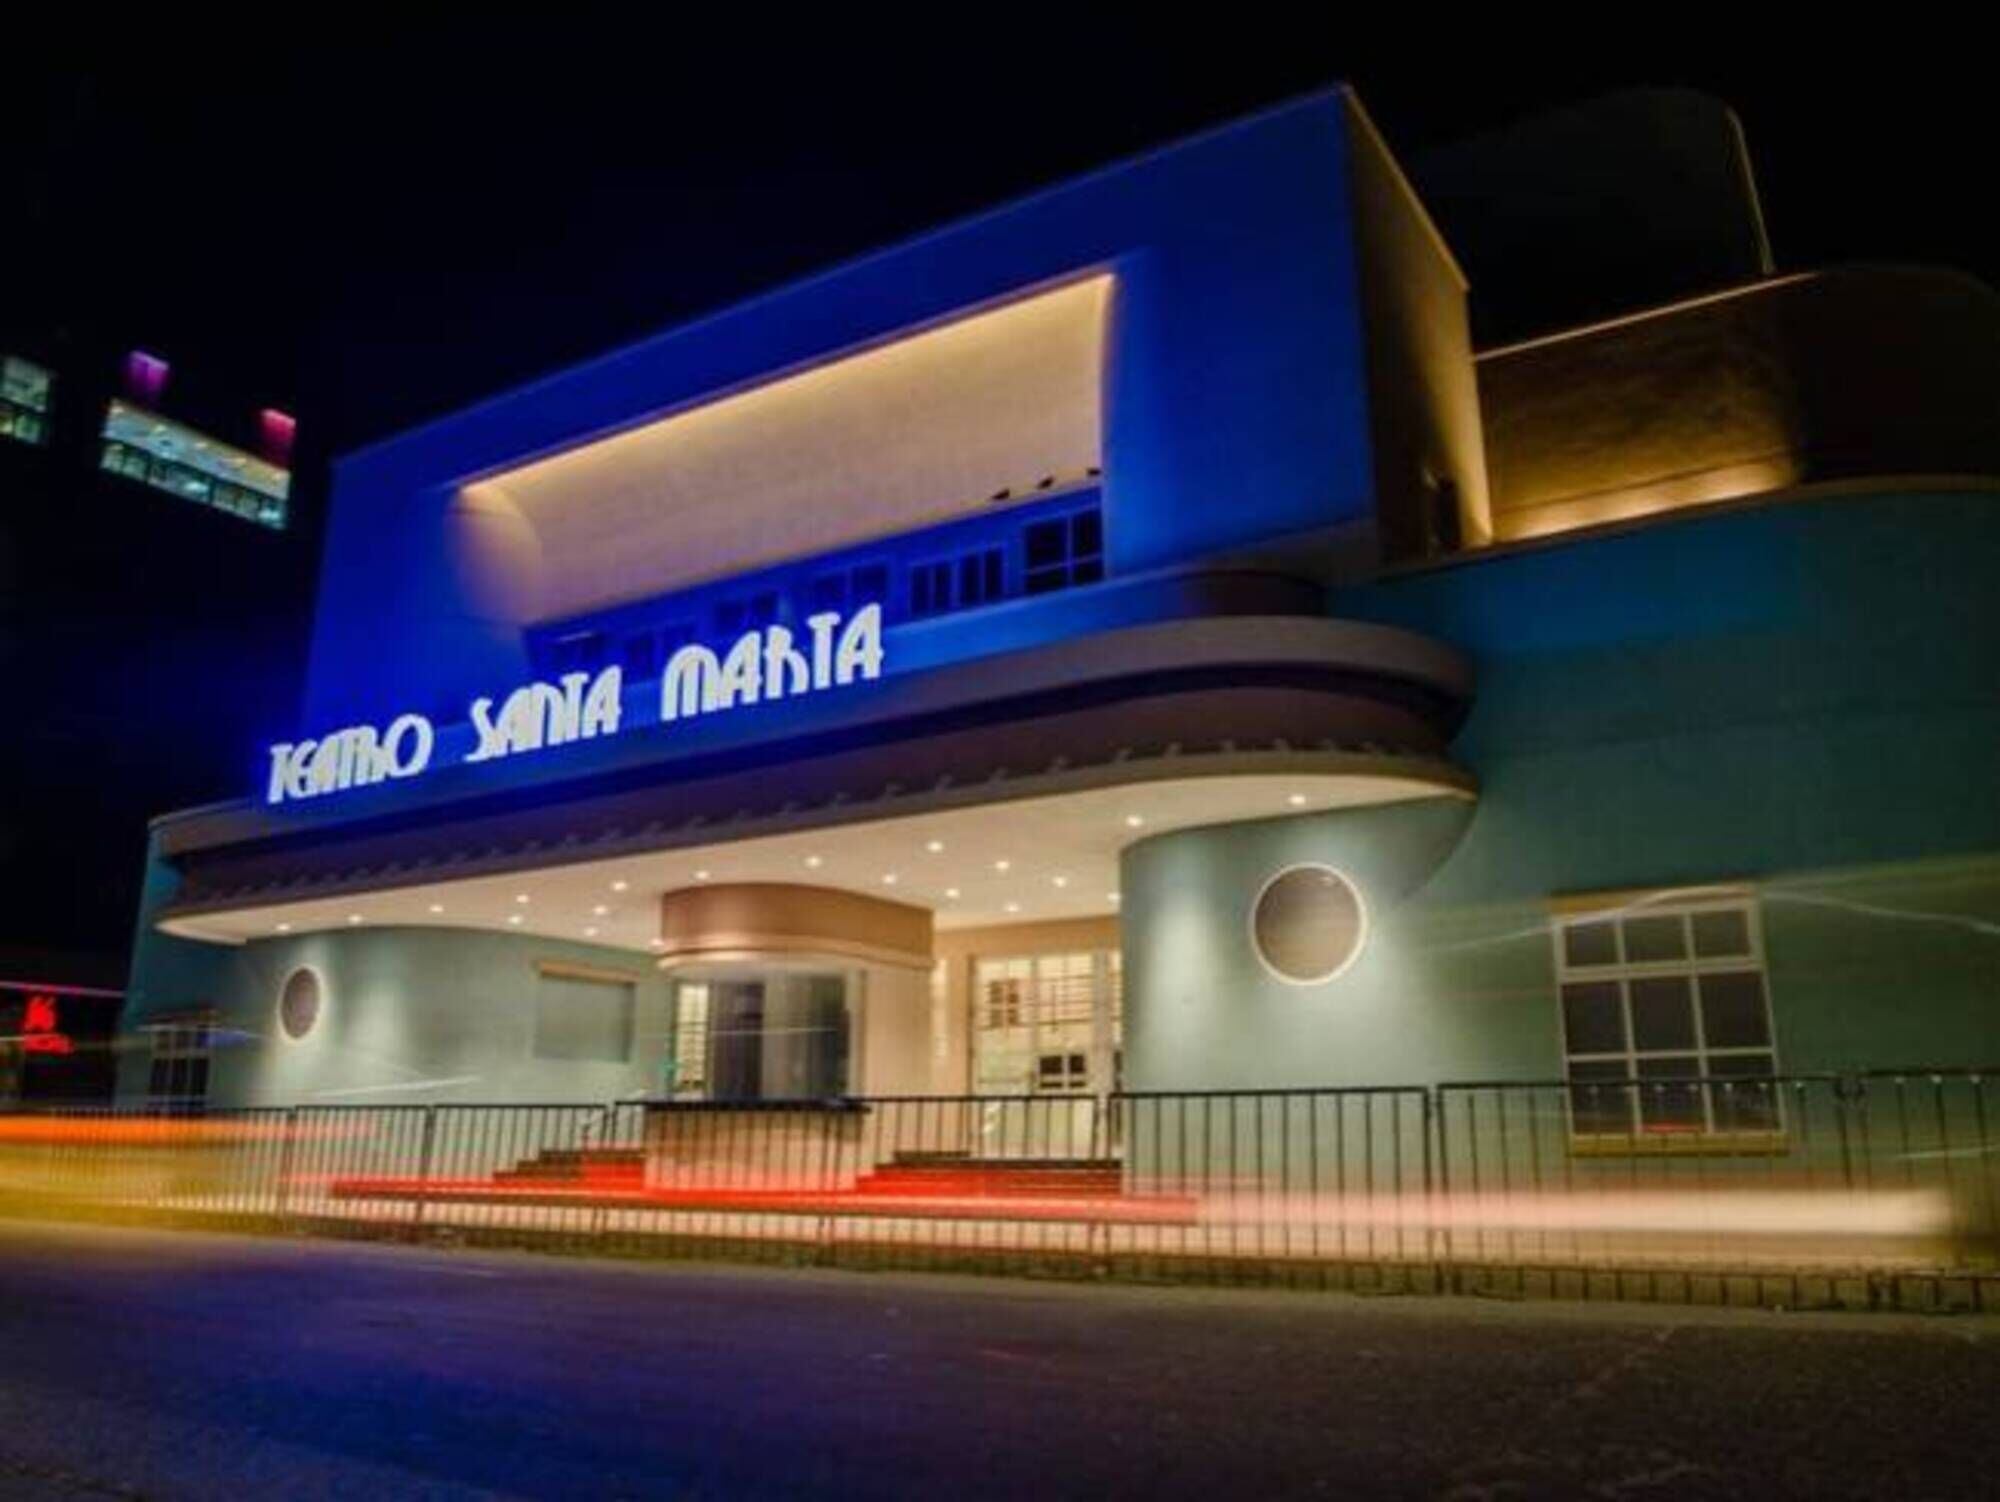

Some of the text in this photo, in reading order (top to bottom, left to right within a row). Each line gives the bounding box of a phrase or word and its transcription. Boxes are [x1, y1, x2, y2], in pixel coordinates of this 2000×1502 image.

[267, 602, 885, 804] TEATRO SANTA MARTA
